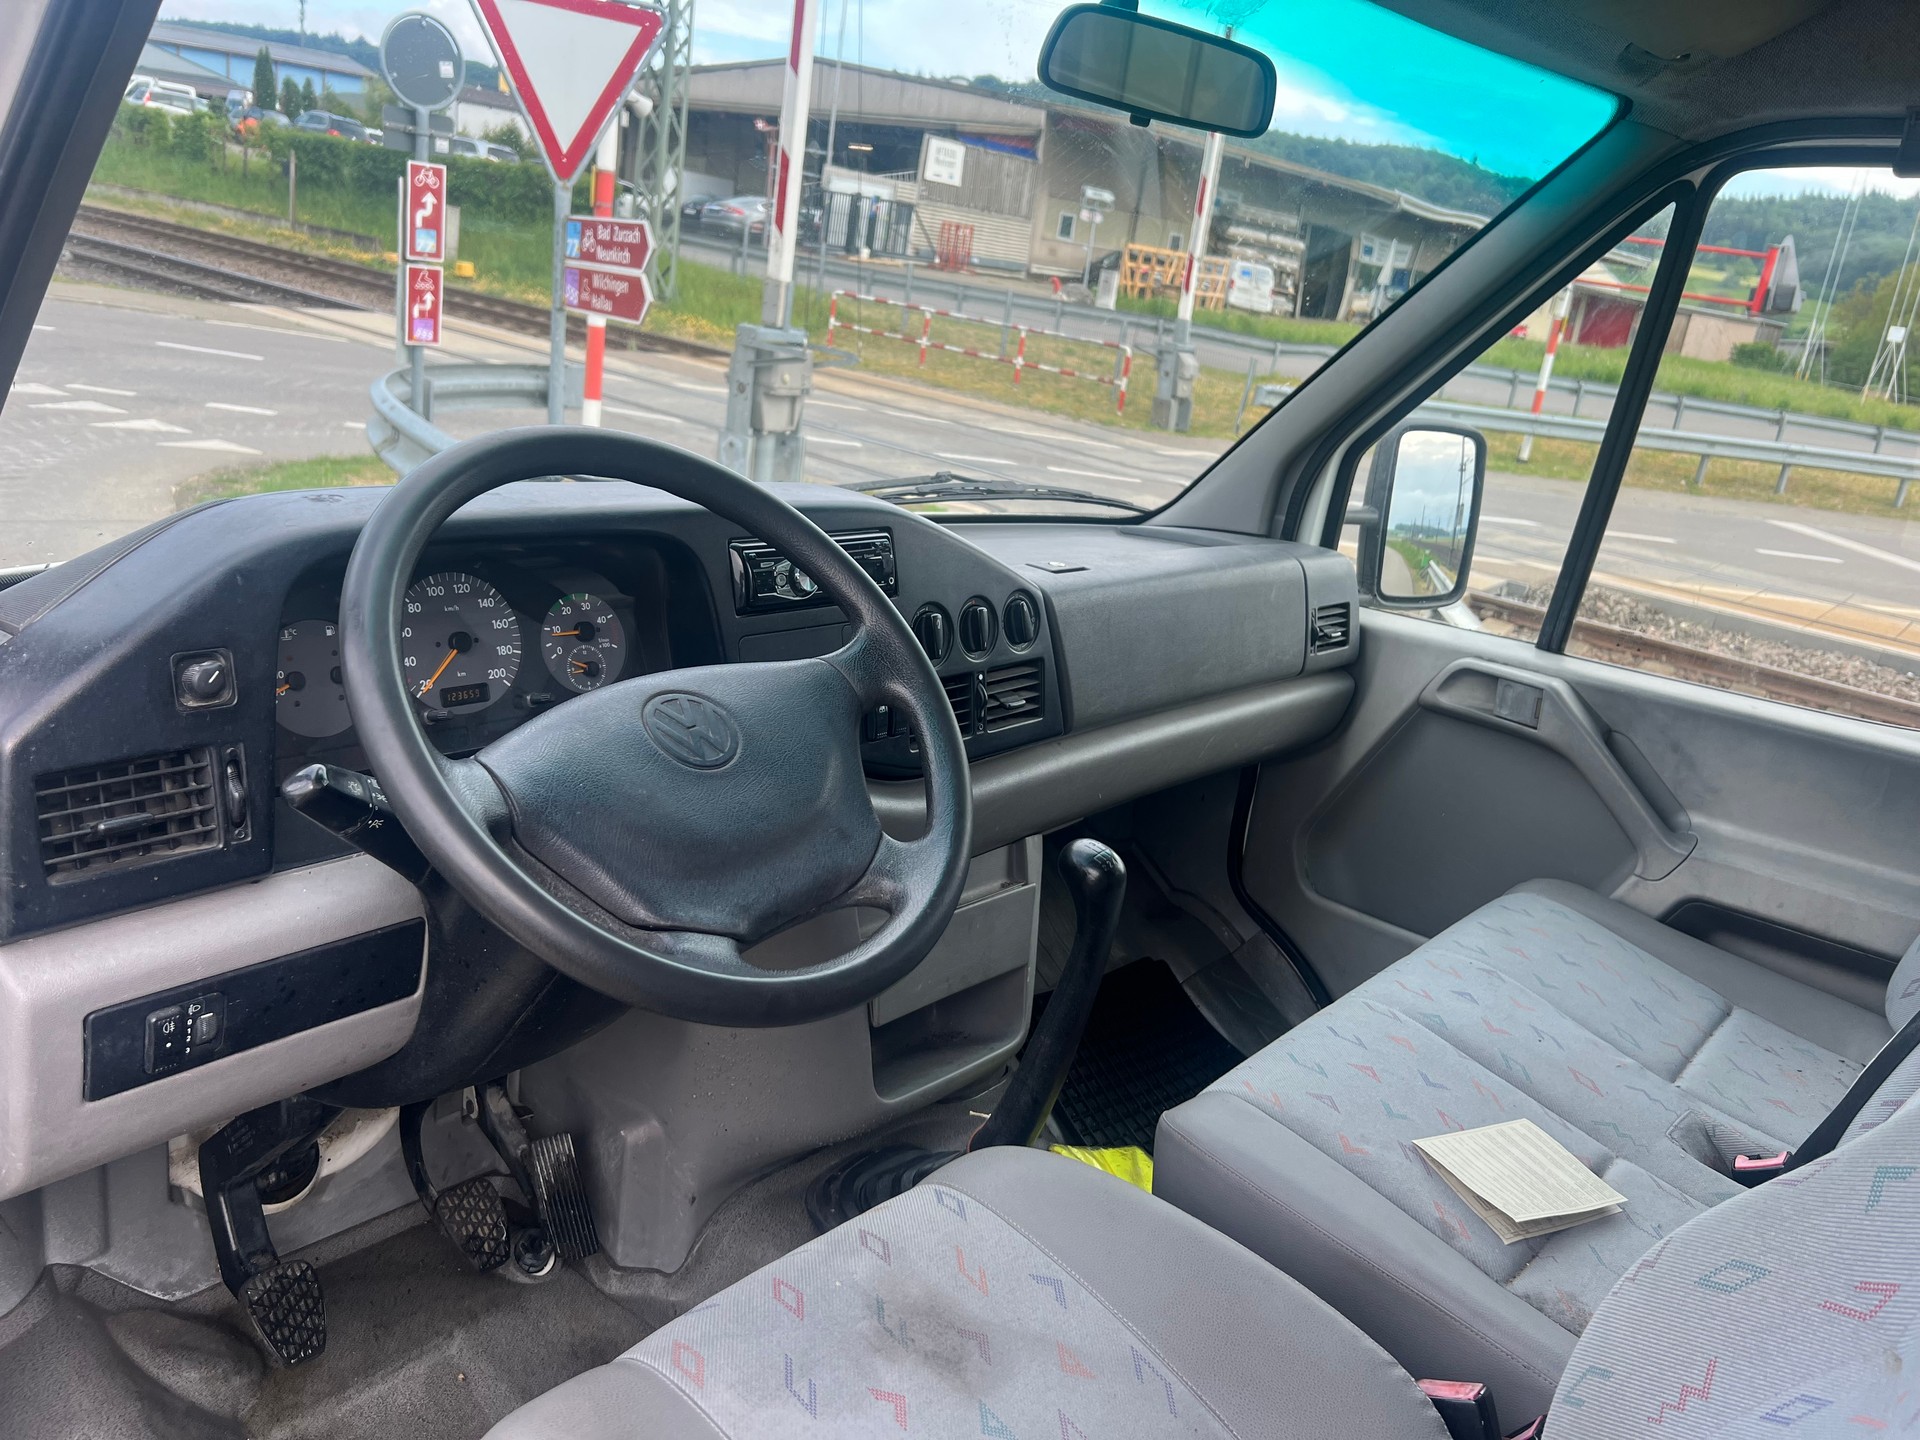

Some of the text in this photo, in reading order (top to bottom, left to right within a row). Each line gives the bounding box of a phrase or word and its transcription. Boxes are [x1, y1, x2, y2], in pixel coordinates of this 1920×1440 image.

[597, 223, 611, 241] Bad
[595, 245, 631, 264] Neunkirch
[591, 273, 629, 297] Wilchingen
[426, 586, 445, 597] 100
[453, 583, 471, 594] 120
[407, 602, 422, 613] 80
[444, 604, 460, 612] km/h
[477, 598, 495, 608] 140
[580, 602, 591, 611] 30
[561, 606, 572, 615] 20
[491, 618, 509, 629] 160
[596, 616, 607, 624] 40
[552, 625, 561, 633] 10
[496, 644, 513, 656] 180
[556, 646, 563, 655] 0
[487, 667, 507, 679] 200
[447, 688, 480, 701] 123659
